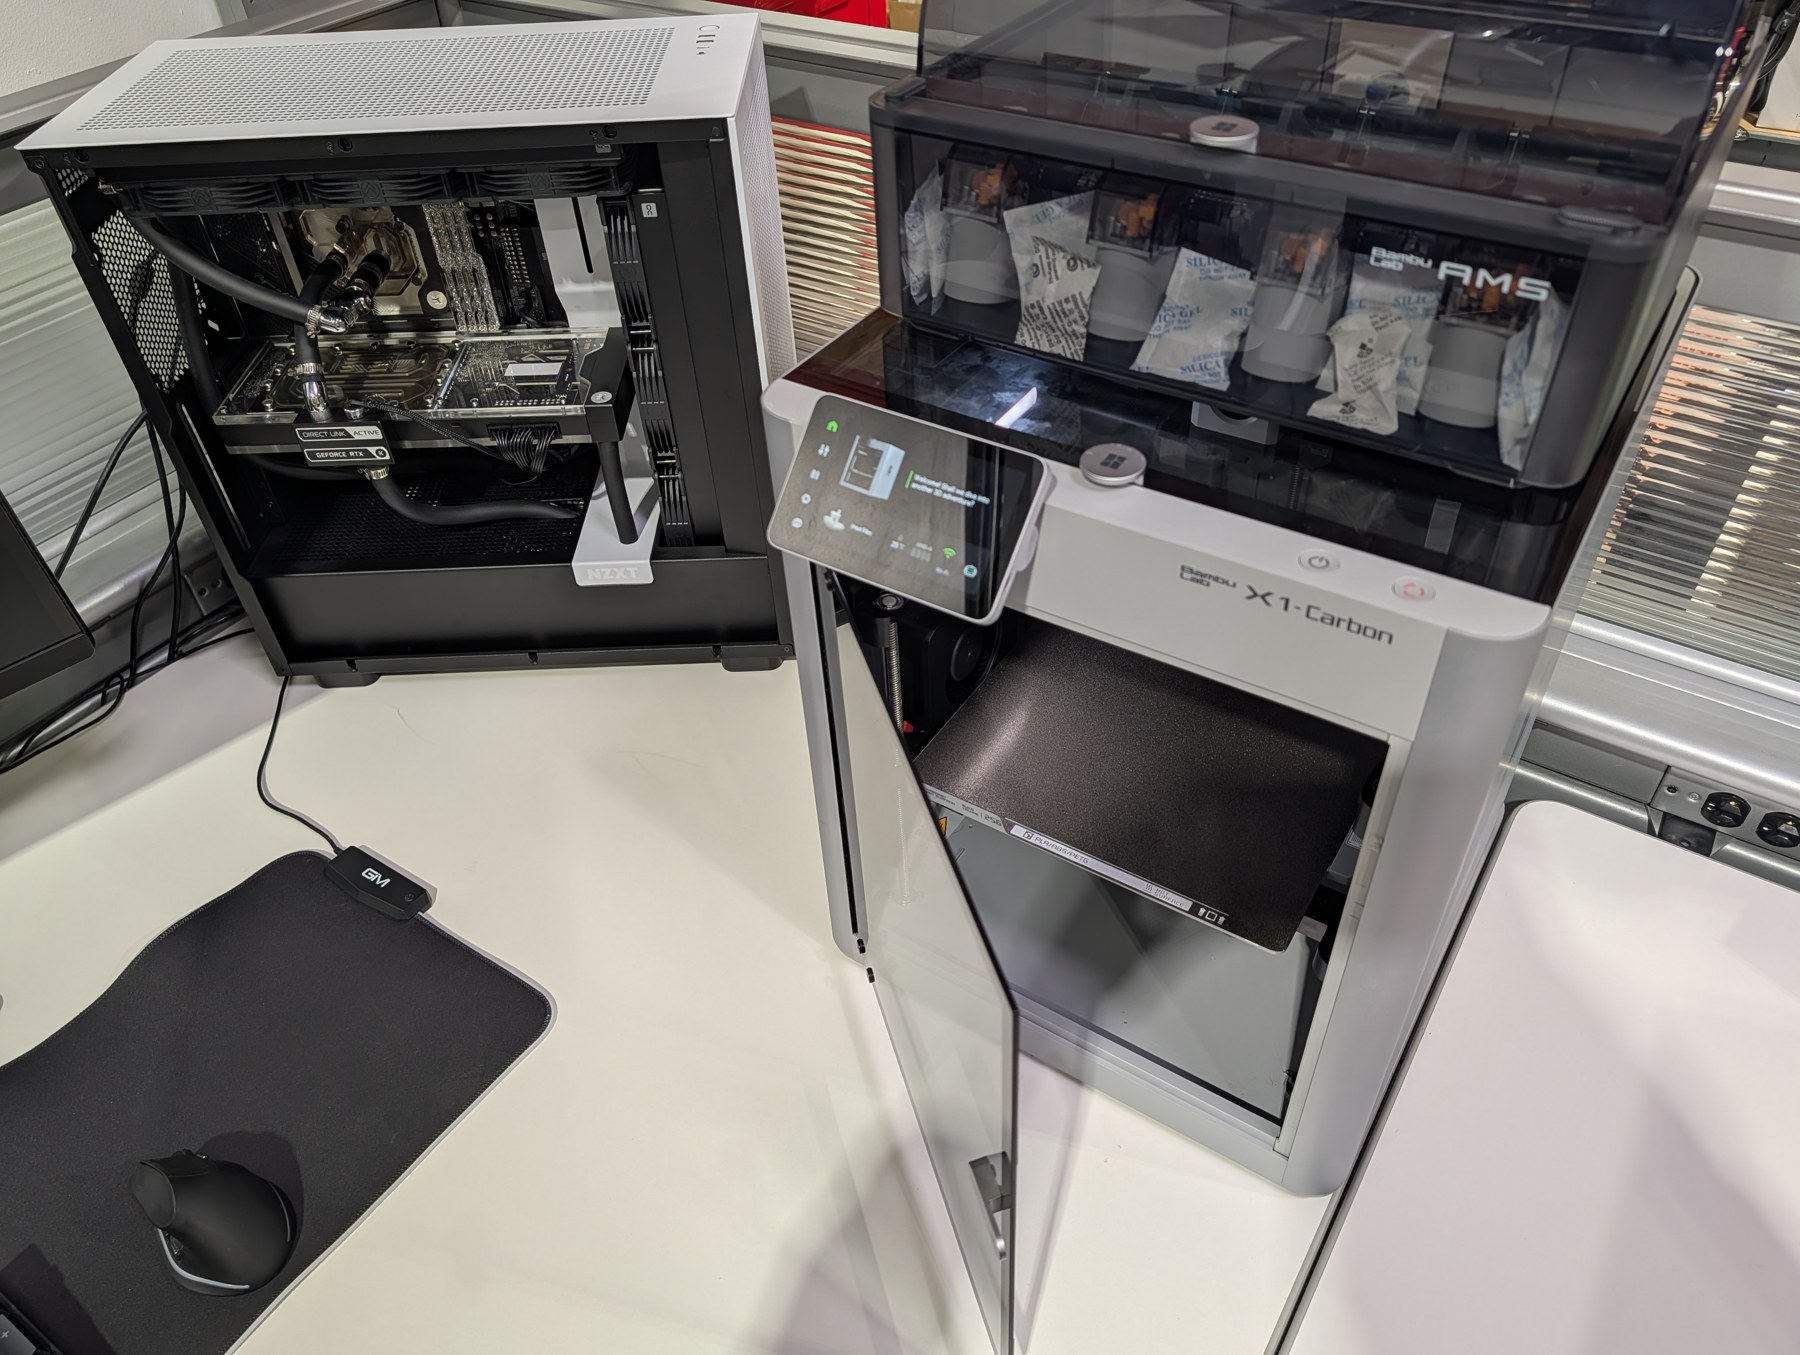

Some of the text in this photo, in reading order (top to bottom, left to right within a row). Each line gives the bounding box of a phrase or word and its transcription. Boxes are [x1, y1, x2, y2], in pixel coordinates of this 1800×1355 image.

[1185, 256, 1222, 268] SILIC
[1369, 257, 1403, 272] Lab
[1371, 246, 1433, 268] Bambu
[1437, 260, 1551, 302] AMS
[586, 567, 638, 580] NZXT
[1179, 573, 1211, 587] Lab
[1180, 564, 1237, 588] Bambu
[1034, 836, 1089, 864] PLA/ABS/PETG
